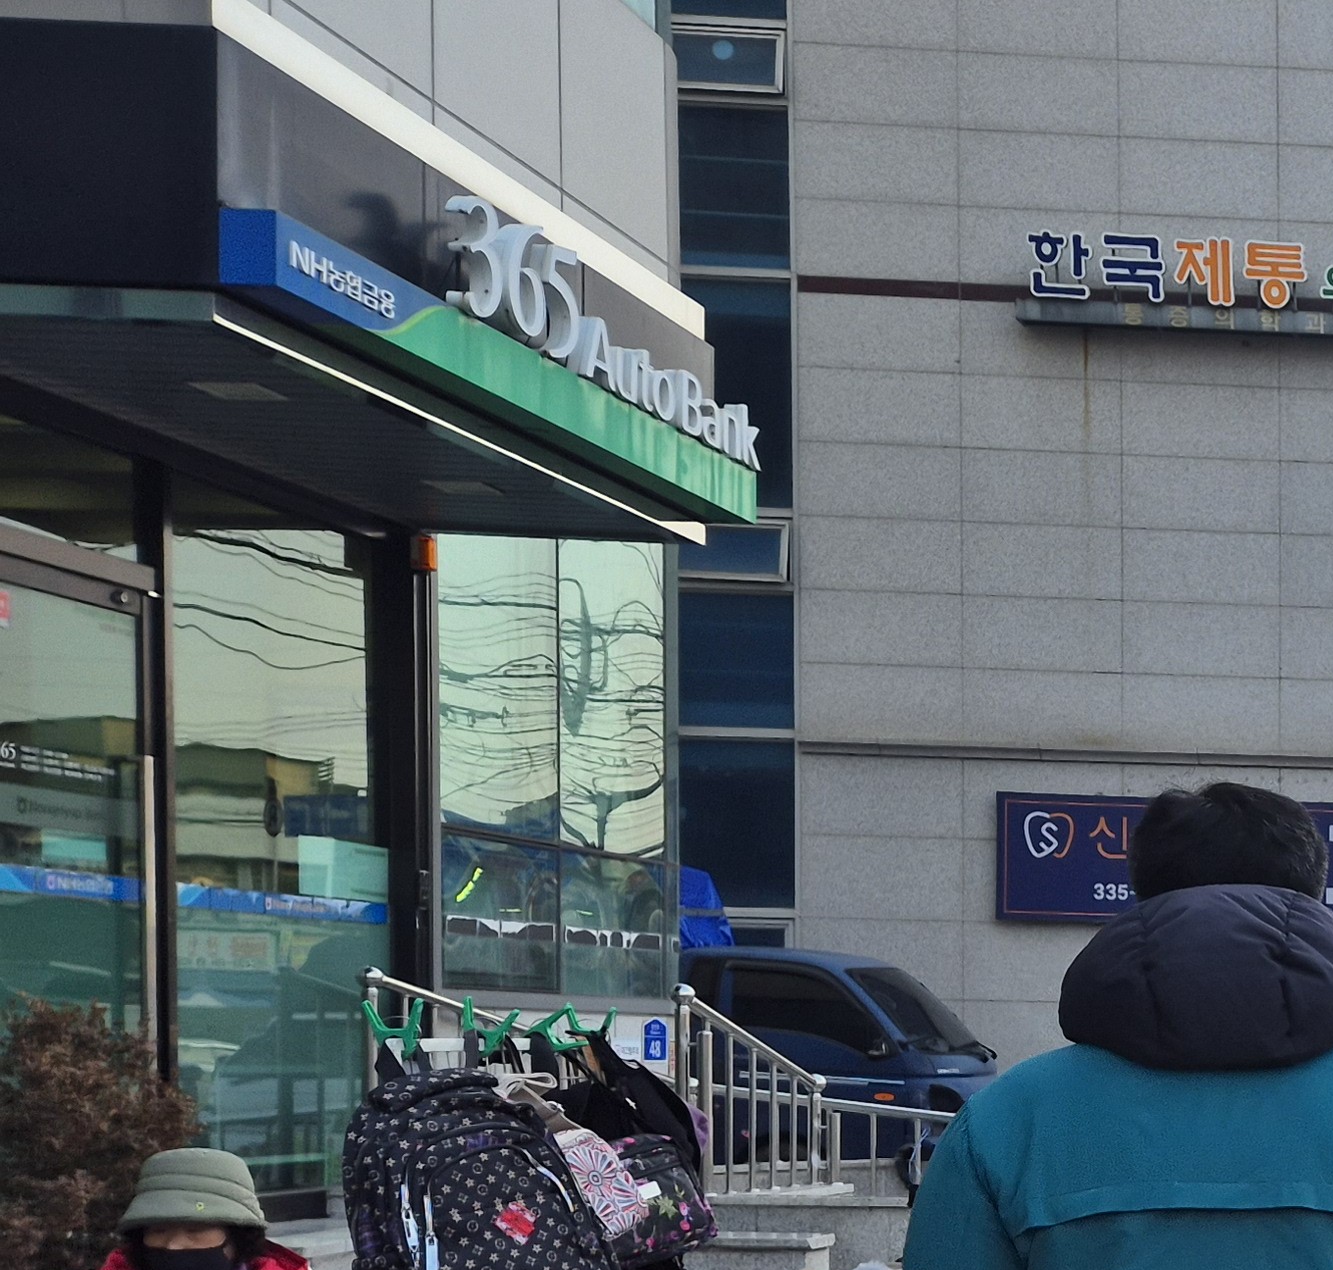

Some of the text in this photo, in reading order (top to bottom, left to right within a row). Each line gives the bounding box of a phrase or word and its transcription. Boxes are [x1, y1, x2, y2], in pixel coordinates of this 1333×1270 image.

[289, 240, 397, 320] NH농협금융
[445, 195, 580, 358] 365
[649, 1040, 661, 1058] 48
